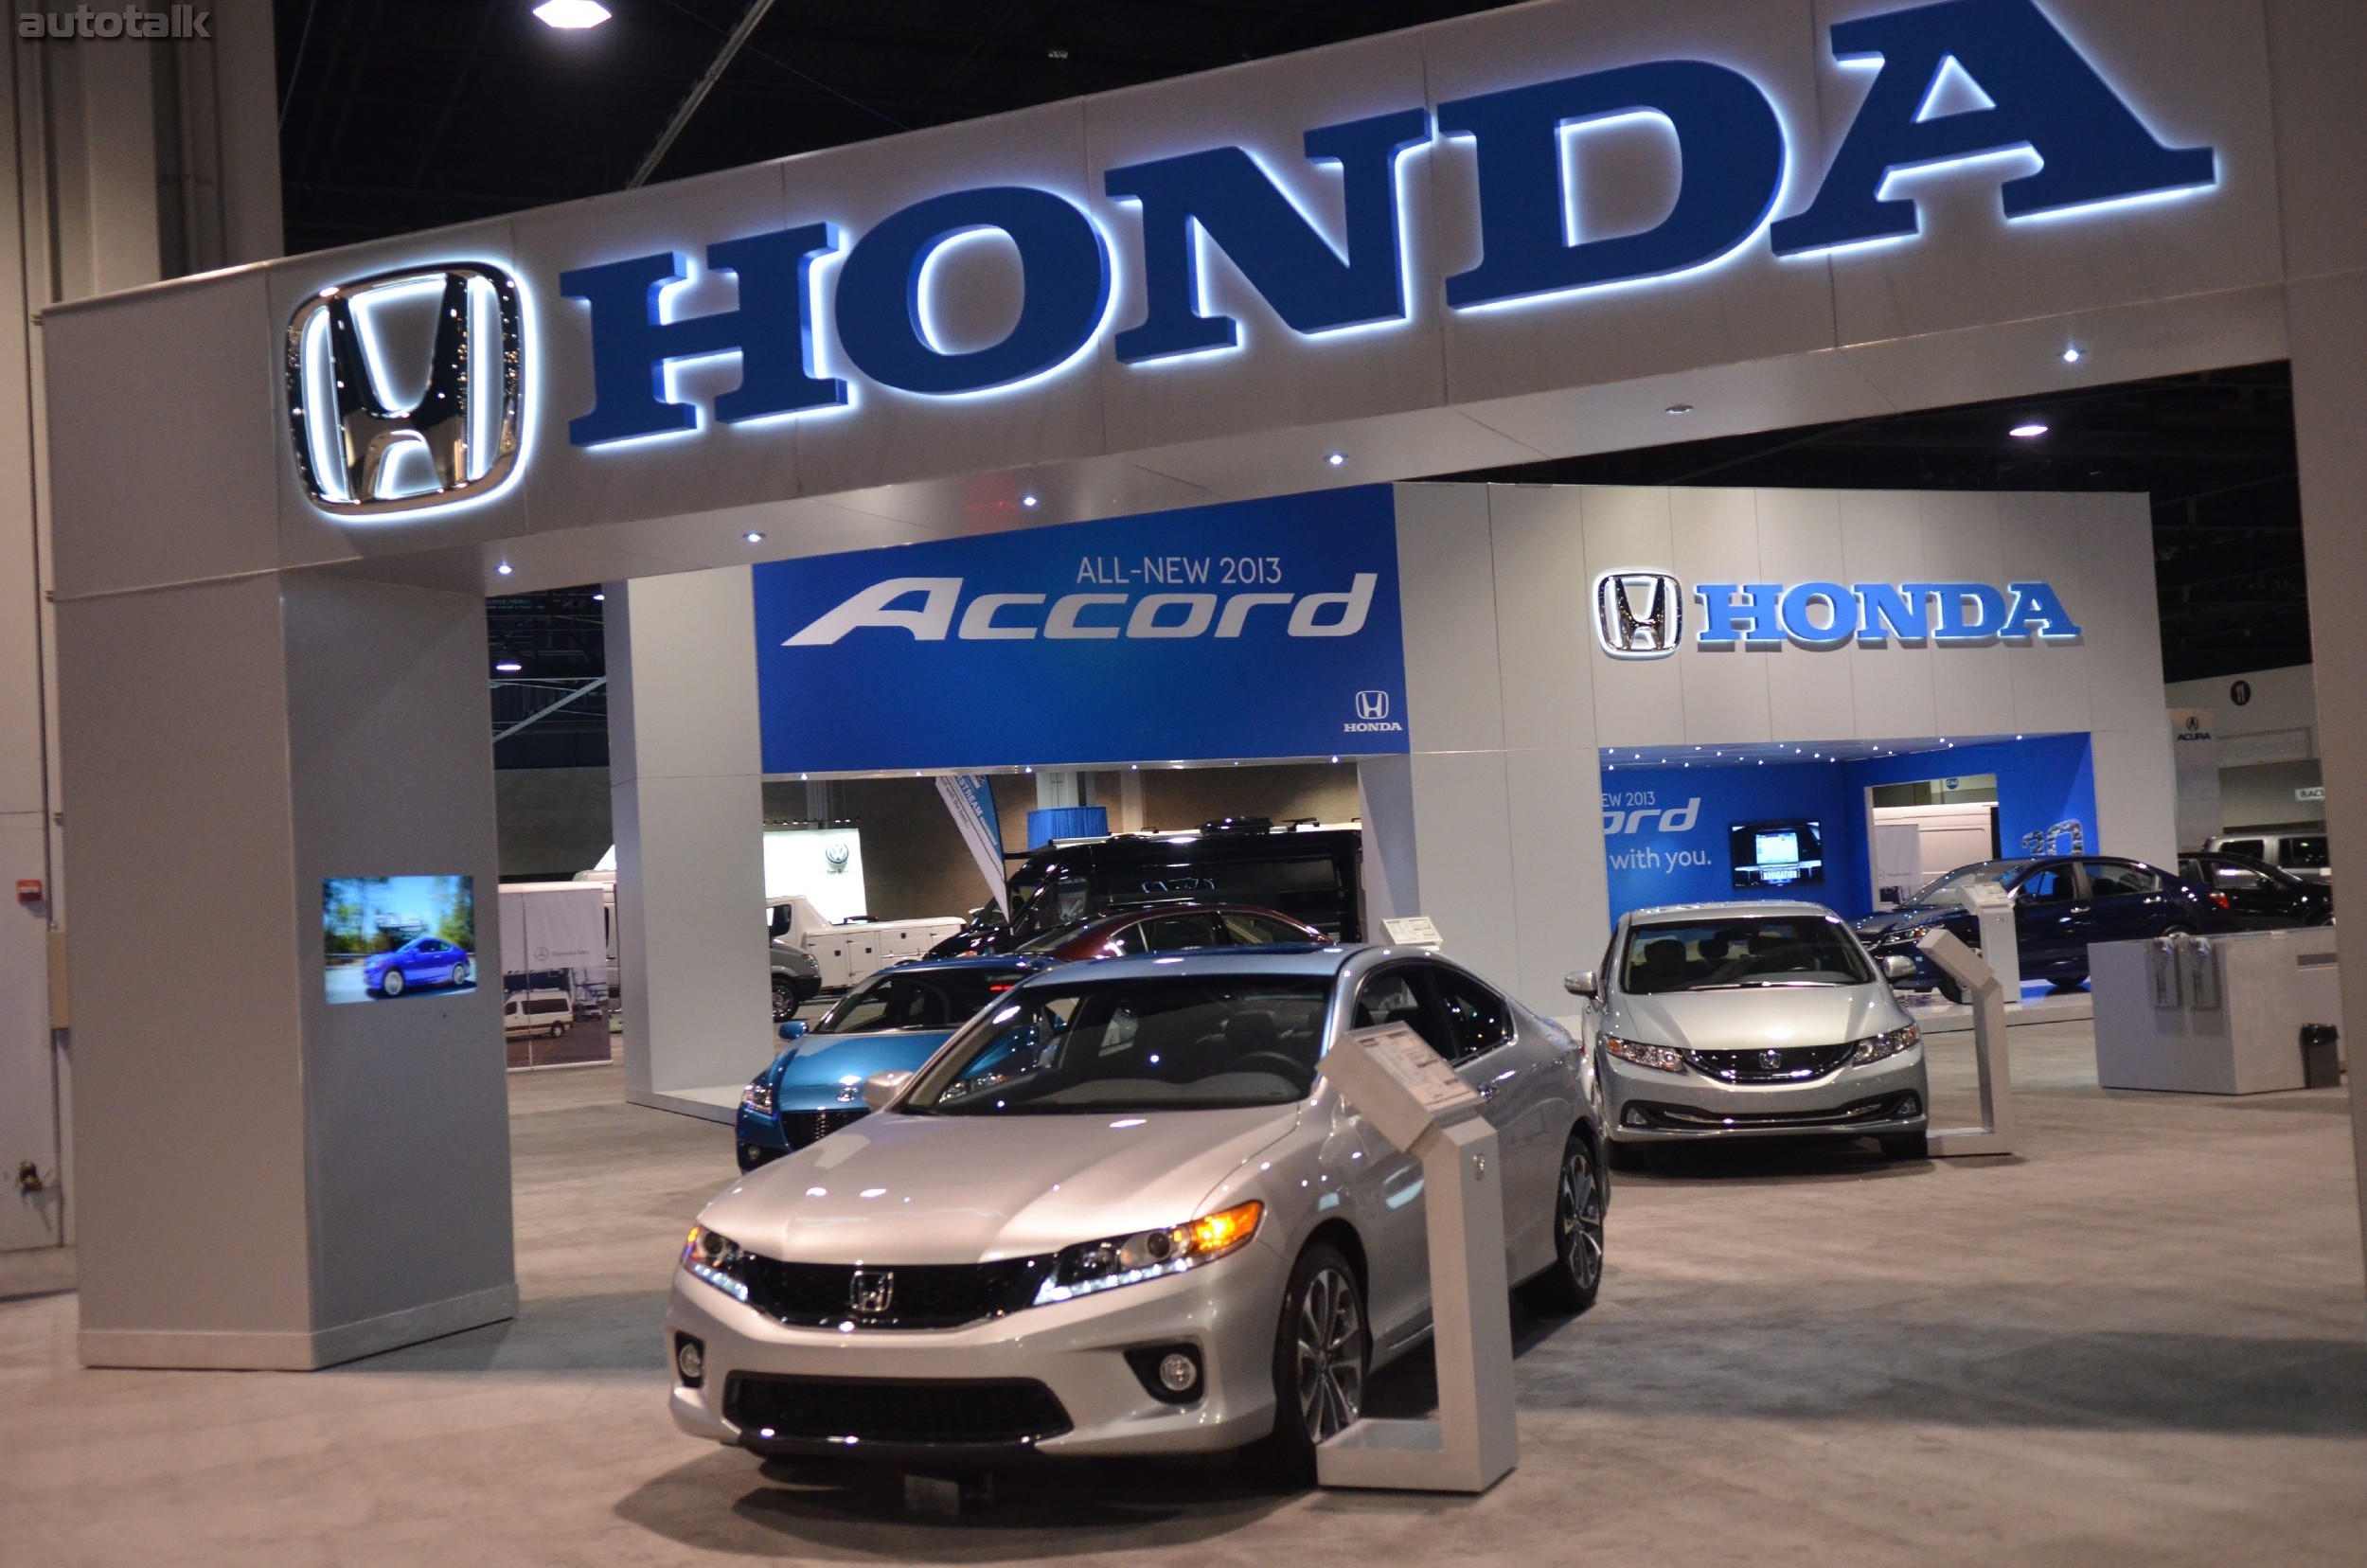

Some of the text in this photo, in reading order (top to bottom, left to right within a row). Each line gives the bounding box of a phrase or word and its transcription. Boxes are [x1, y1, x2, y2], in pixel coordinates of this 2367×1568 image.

[560, 0, 2217, 449] HONDA
[1077, 556, 1283, 584] ALL-NEW 2013
[780, 572, 1379, 647] Accord
[1695, 580, 2081, 643] HONDA
[1344, 722, 1403, 733] HONDA
[2178, 732, 2212, 741] ACURA
[1626, 791, 1656, 807] 2013
[1610, 846, 1712, 874] with you.
